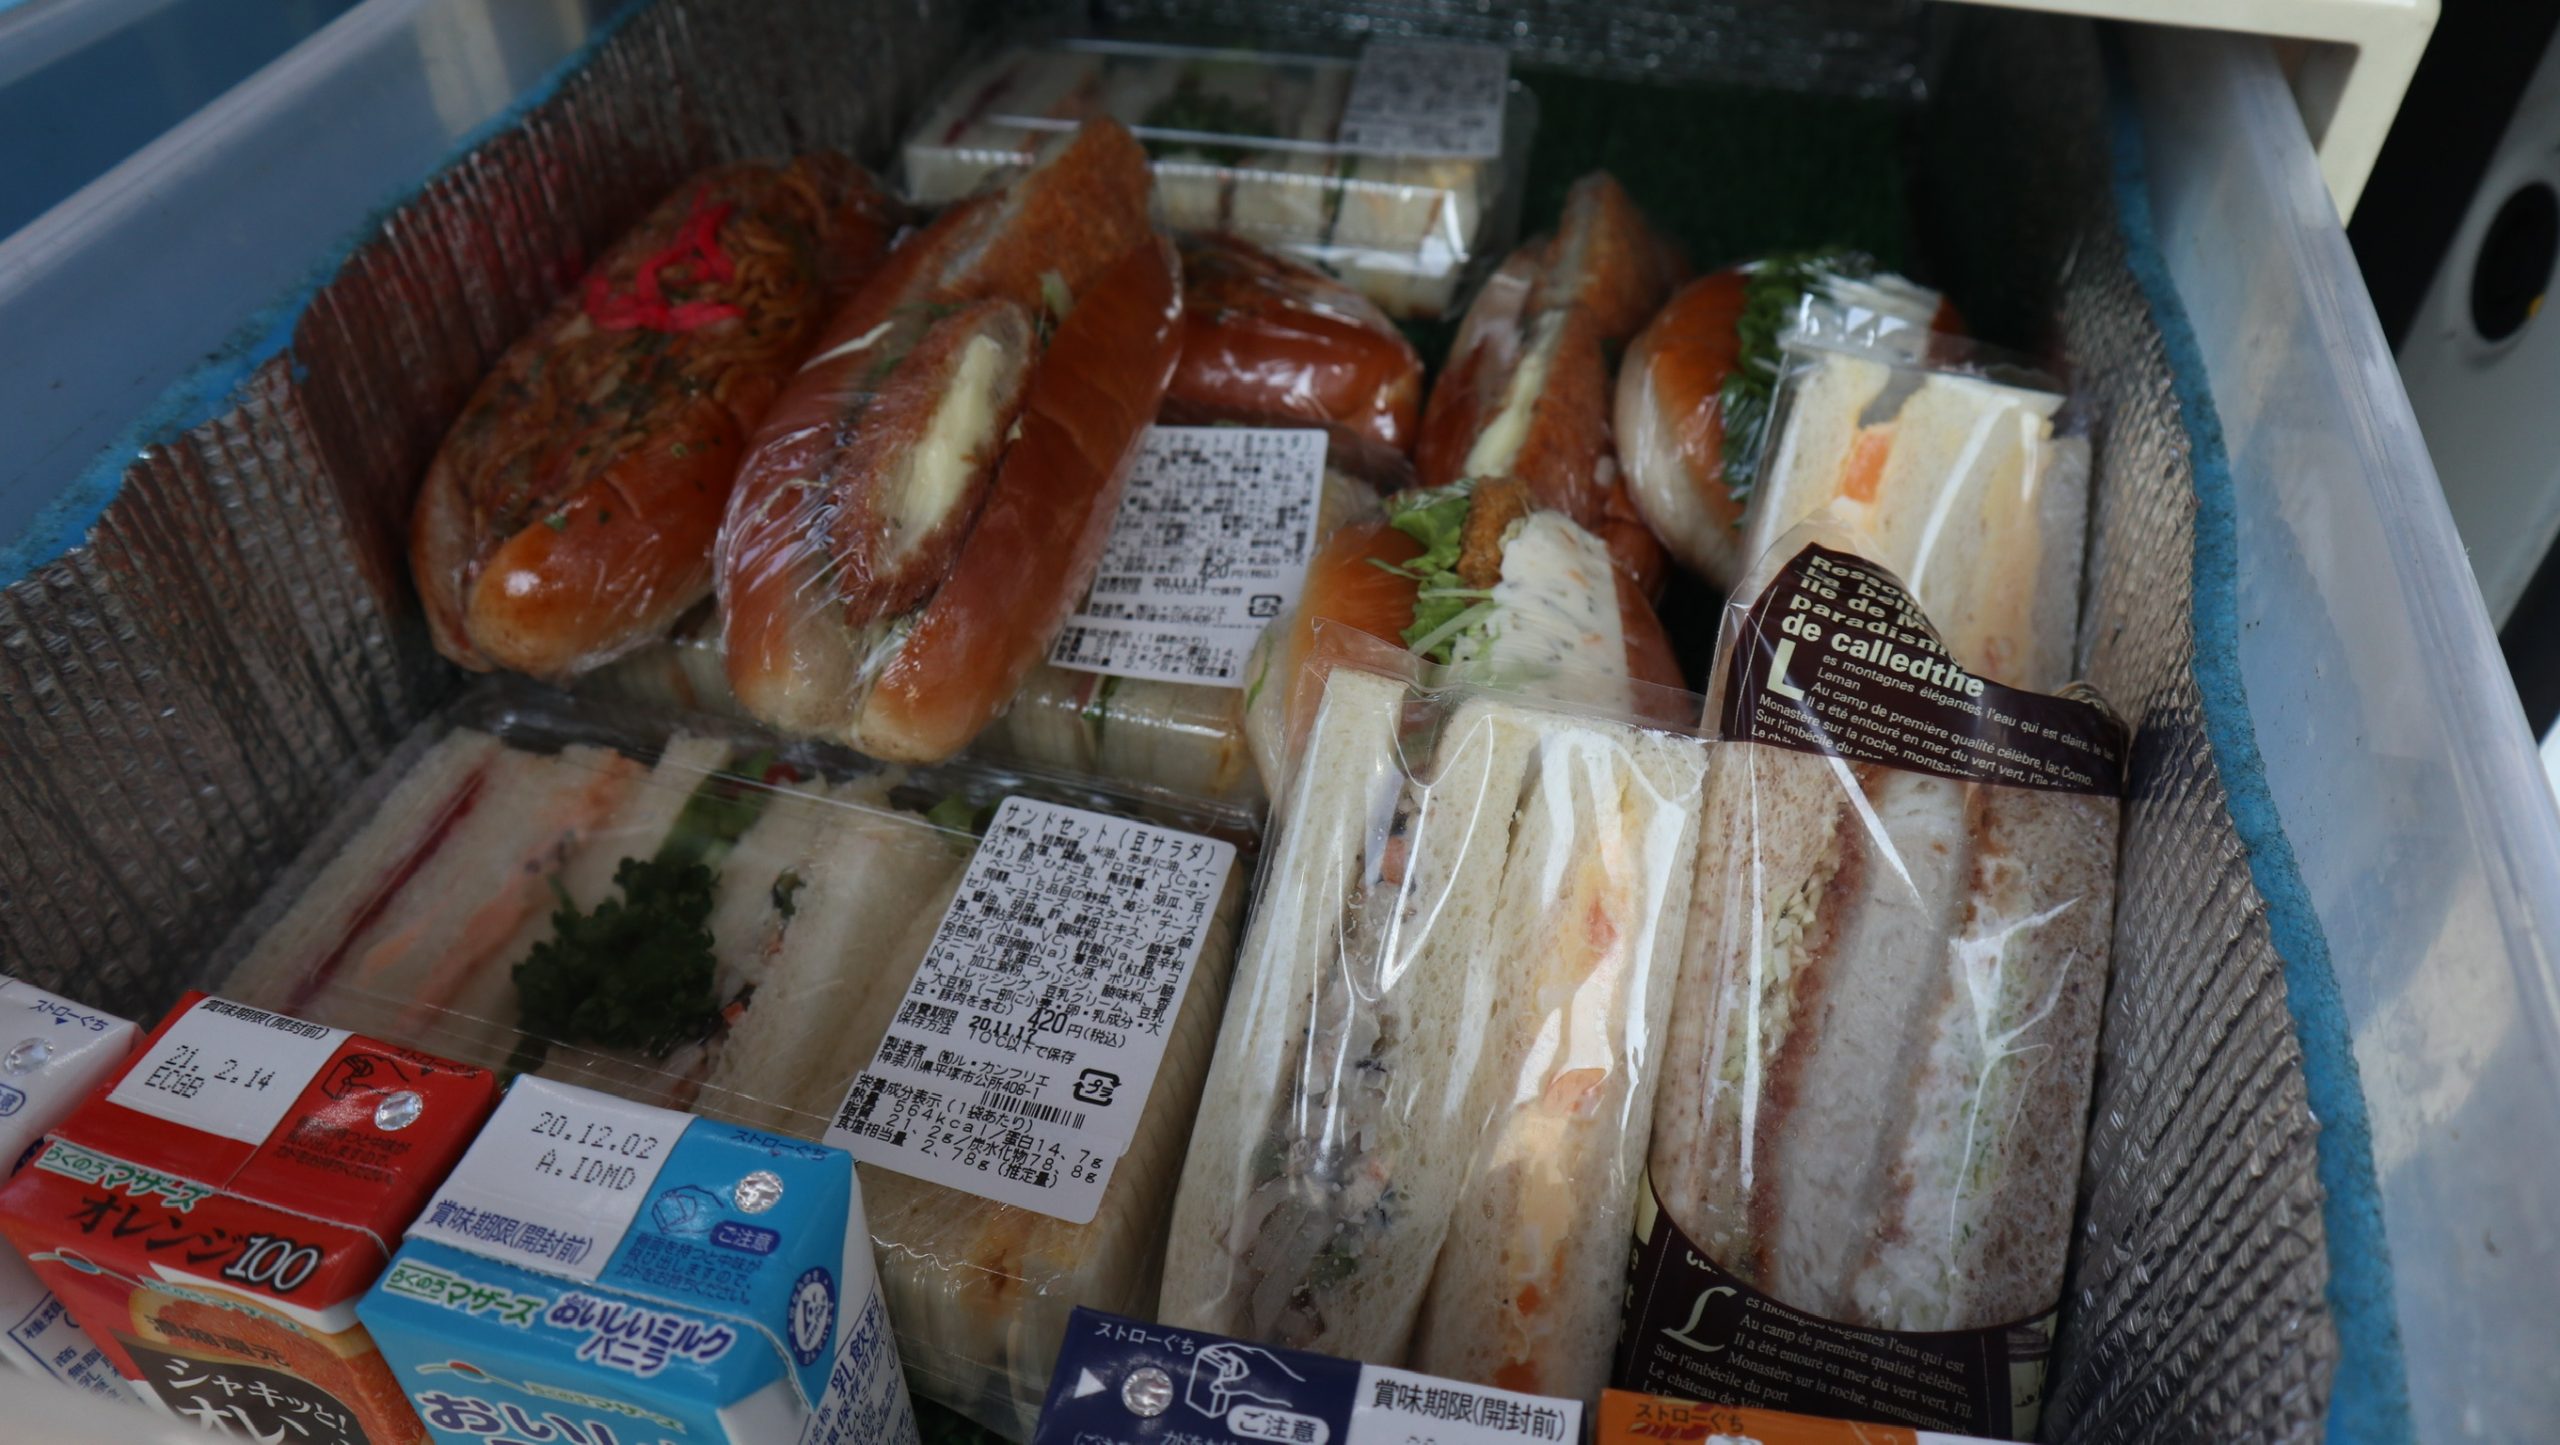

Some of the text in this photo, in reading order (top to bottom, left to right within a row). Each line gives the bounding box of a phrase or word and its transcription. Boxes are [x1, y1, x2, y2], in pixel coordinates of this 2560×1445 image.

[1848, 597, 1887, 619] de
[1781, 612, 1985, 698] de calledthe
[1817, 666, 1862, 691] Leman
[1823, 653, 1839, 666] es
[1842, 661, 1916, 693] montagnes
[1919, 687, 1982, 716] élégantes
[1987, 707, 2017, 727] l'eau
[2020, 720, 2040, 735] qui
[1751, 723, 1766, 739] Le
[1755, 708, 1776, 726] Sur
[1777, 718, 1834, 748] l'imbécile
[1836, 741, 1853, 755] du
[1759, 693, 1820, 727] Monastère
[1822, 720, 1844, 735] sur
[1846, 726, 1858, 740] la
[1861, 733, 1900, 757] roche,
[1811, 681, 1830, 697] Au
[1832, 689, 1869, 711] camp
[1871, 703, 1888, 717] de
[1890, 711, 1949, 740] première
[1951, 732, 1995, 754] qualité
[2046, 760, 2060, 776] lac
[2062, 767, 2095, 788] Como.
[1816, 700, 1825, 711] a
[1828, 702, 1848, 720] été
[1850, 712, 1901, 739] entouré
[1903, 732, 1919, 746] en
[1921, 737, 1949, 755] mer
[1951, 748, 1968, 763] du
[1971, 755, 1996, 772] vert
[1999, 763, 2026, 784] vert,
[29, 999, 109, 1033] ストローぐち
[200, 999, 331, 1041] 賞味期限(開封前)
[968, 1015, 1037, 1043] 20.11.17
[1027, 1007, 1068, 1034] 420
[883, 1035, 927, 1059] 製造者
[530, 1110, 661, 1162] 20.12.02
[423, 1198, 594, 1267] 賞味期限(開封前)
[550, 1292, 733, 1359] おいしいミルク
[1093, 1321, 1197, 1357] ストローぐち
[1738, 1313, 1760, 1332] Au
[1762, 1323, 1796, 1343] camp
[1798, 1331, 1813, 1347] de
[1814, 1335, 1869, 1365] première
[1871, 1351, 1916, 1379] qualité
[581, 1335, 666, 1372] バニラ
[1654, 1344, 1678, 1362] Sur
[1679, 1354, 1743, 1388] l'imbécile
[1744, 1378, 1763, 1394] du
[1746, 1338, 1757, 1351] a
[1758, 1340, 1778, 1358] été
[1779, 1348, 1825, 1373] entouré
[1825, 1361, 1841, 1375] en
[1842, 1367, 1870, 1385] mer
[1871, 1375, 1889, 1392] du
[1892, 1382, 1918, 1402] vert
[1888, 1334, 1919, 1359] l'eau
[1921, 1346, 1945, 1367] qui
[1946, 1358, 1966, 1374] est
[1648, 1362, 1666, 1379] Le
[1667, 1373, 1718, 1401] château
[1719, 1391, 1737, 1406] de
[1727, 1351, 1793, 1383] Monastère
[1795, 1374, 1815, 1389] sur
[1816, 1376, 1828, 1393] la
[1829, 1384, 1870, 1408] roche,
[1237, 1408, 1318, 1445] ご注意
[1371, 1378, 1567, 1443] 賞味期限(開封前)
[1634, 1402, 1744, 1434] ストローぐち
